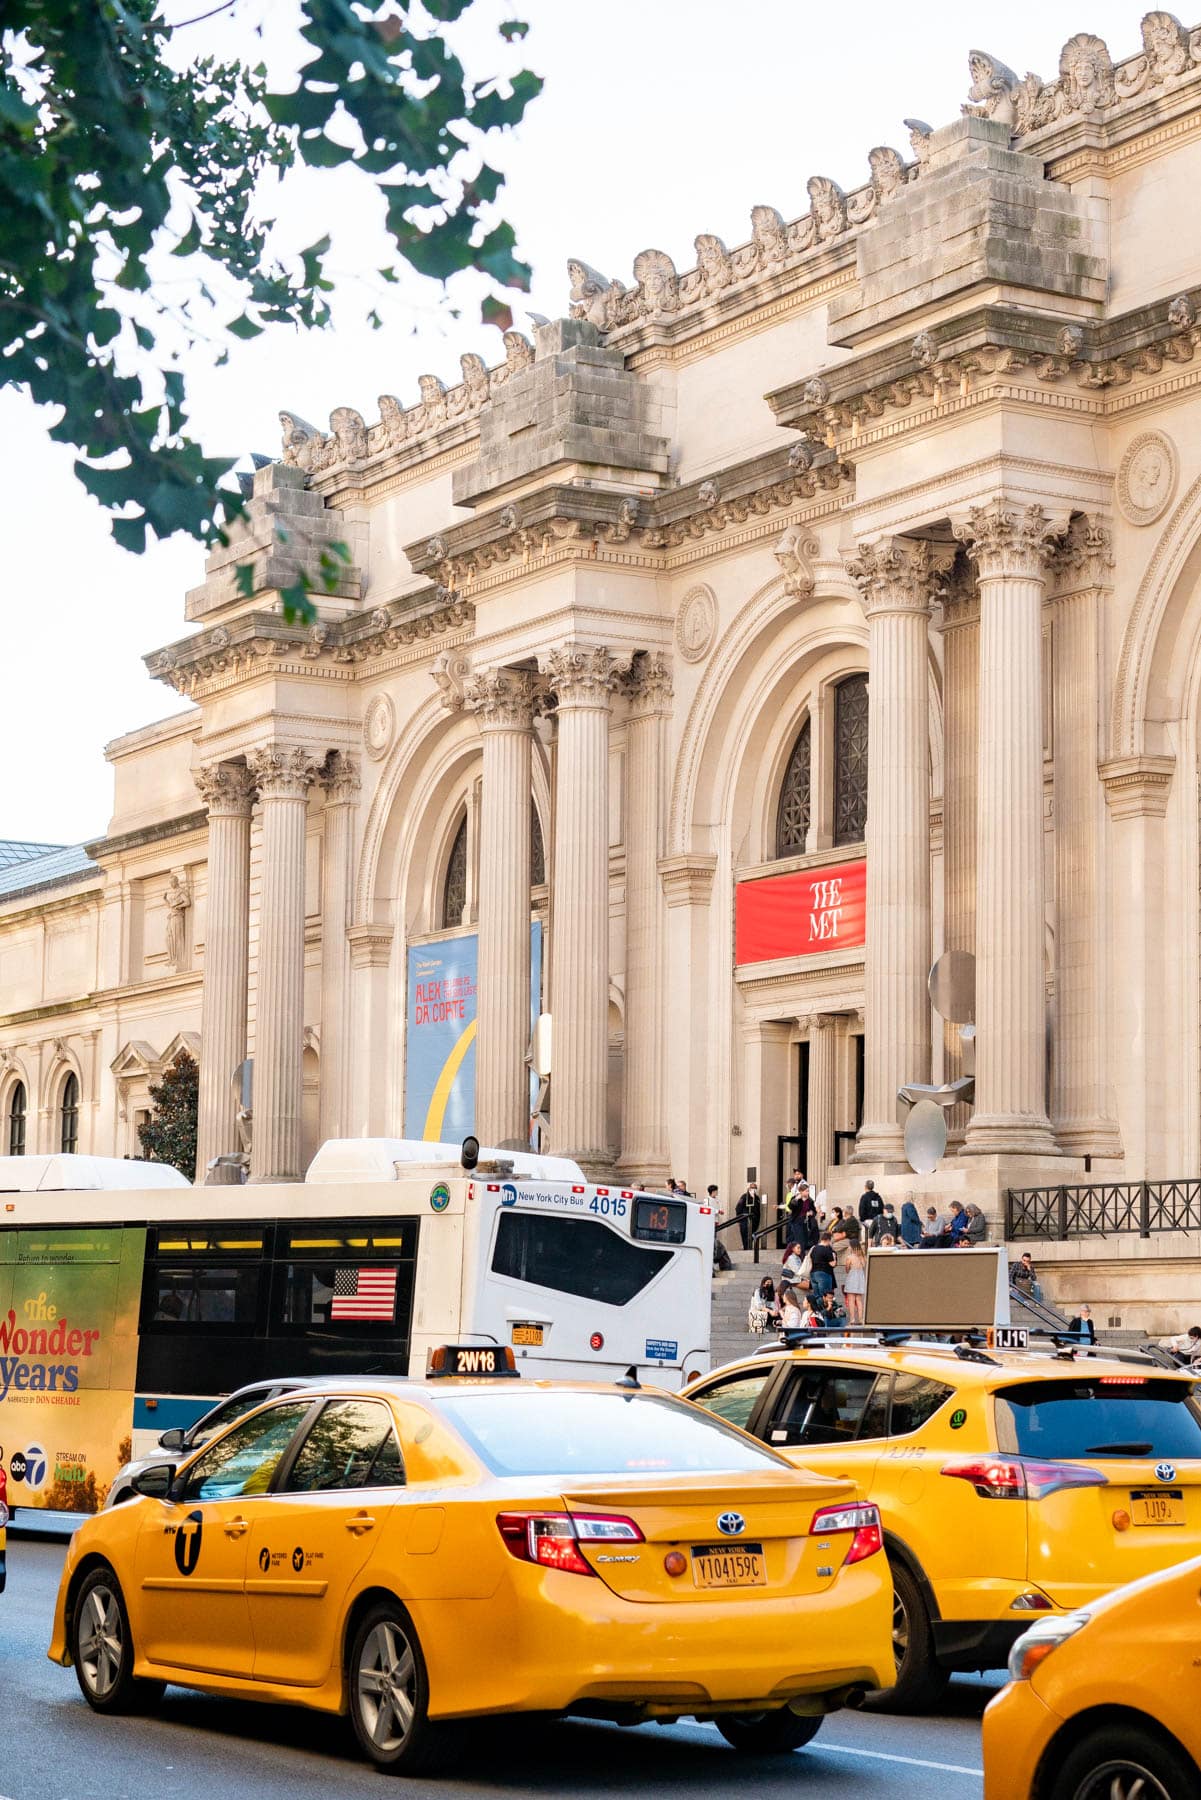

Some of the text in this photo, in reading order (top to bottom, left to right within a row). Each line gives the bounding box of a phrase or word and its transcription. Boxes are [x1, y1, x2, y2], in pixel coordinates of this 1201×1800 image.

[809, 878, 842, 909] THE
[808, 908, 842, 941] MET
[416, 981, 441, 1003] ALEX
[416, 999, 465, 1025] DA CORTE
[518, 1191, 584, 1206] New York City Bus
[589, 1196, 627, 1217] 4015
[24, 1291, 57, 1321] The
[0, 1308, 100, 1357] Wonder
[997, 1330, 1027, 1347] 1J19
[457, 1351, 495, 1372] 2W18
[36, 1395, 50, 1405] DON
[51, 1396, 80, 1406] CHEADLE
[55, 1452, 86, 1462] STREAM ON
[11, 1460, 26, 1472] abc
[25, 1452, 46, 1487] 7
[55, 1463, 86, 1482] hulu
[699, 1556, 760, 1580] Y104159C
